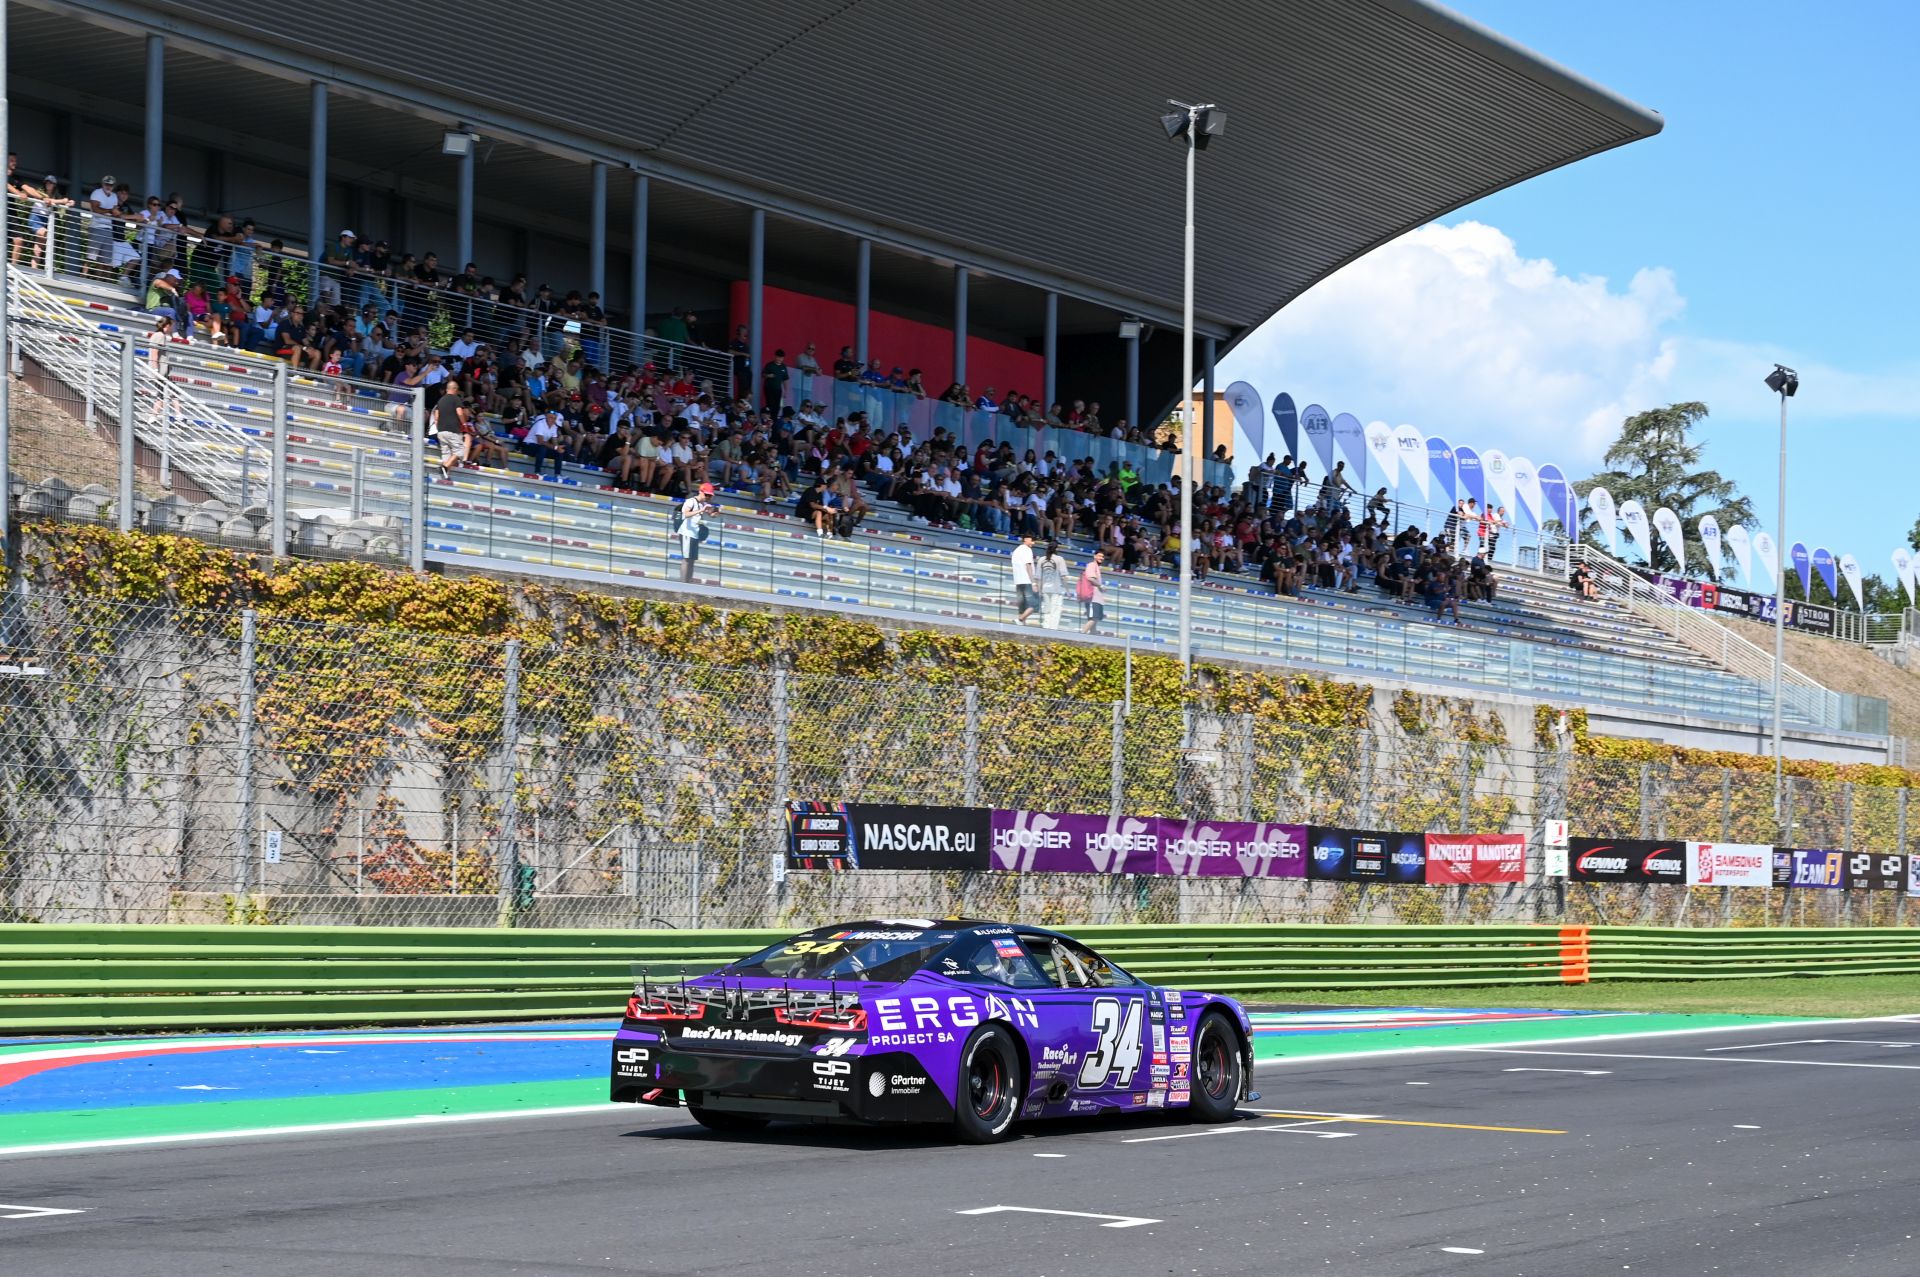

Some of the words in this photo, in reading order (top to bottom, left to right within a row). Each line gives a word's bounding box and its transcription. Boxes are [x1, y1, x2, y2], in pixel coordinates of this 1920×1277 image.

[864, 823, 976, 852] NASCAR.eu
[993, 828, 1071, 849] HOOSIER
[1085, 832, 1158, 851] HOOSIER
[1165, 839, 1231, 857] HOOSIER
[1236, 842, 1300, 858] HOOSIER
[1580, 857, 1629, 870] KENNOL
[1645, 859, 1682, 871] KENNOL
[1716, 855, 1762, 868] SAMSONAS
[846, 932, 923, 940] NASCAR
[783, 941, 844, 955] 34
[734, 1029, 803, 1046] Technology
[872, 1033, 933, 1046] PROJECT
[938, 1032, 955, 1043] SA
[1077, 997, 1144, 1089] 34
[816, 1038, 857, 1057] 34
[1043, 1046, 1065, 1060] Race
[1062, 1051, 1077, 1065] Art
[621, 1064, 643, 1073] TIJEY
[1037, 1062, 1061, 1071] Technology
[818, 1077, 845, 1087] TIJEY
[891, 1074, 926, 1085] GPartner
